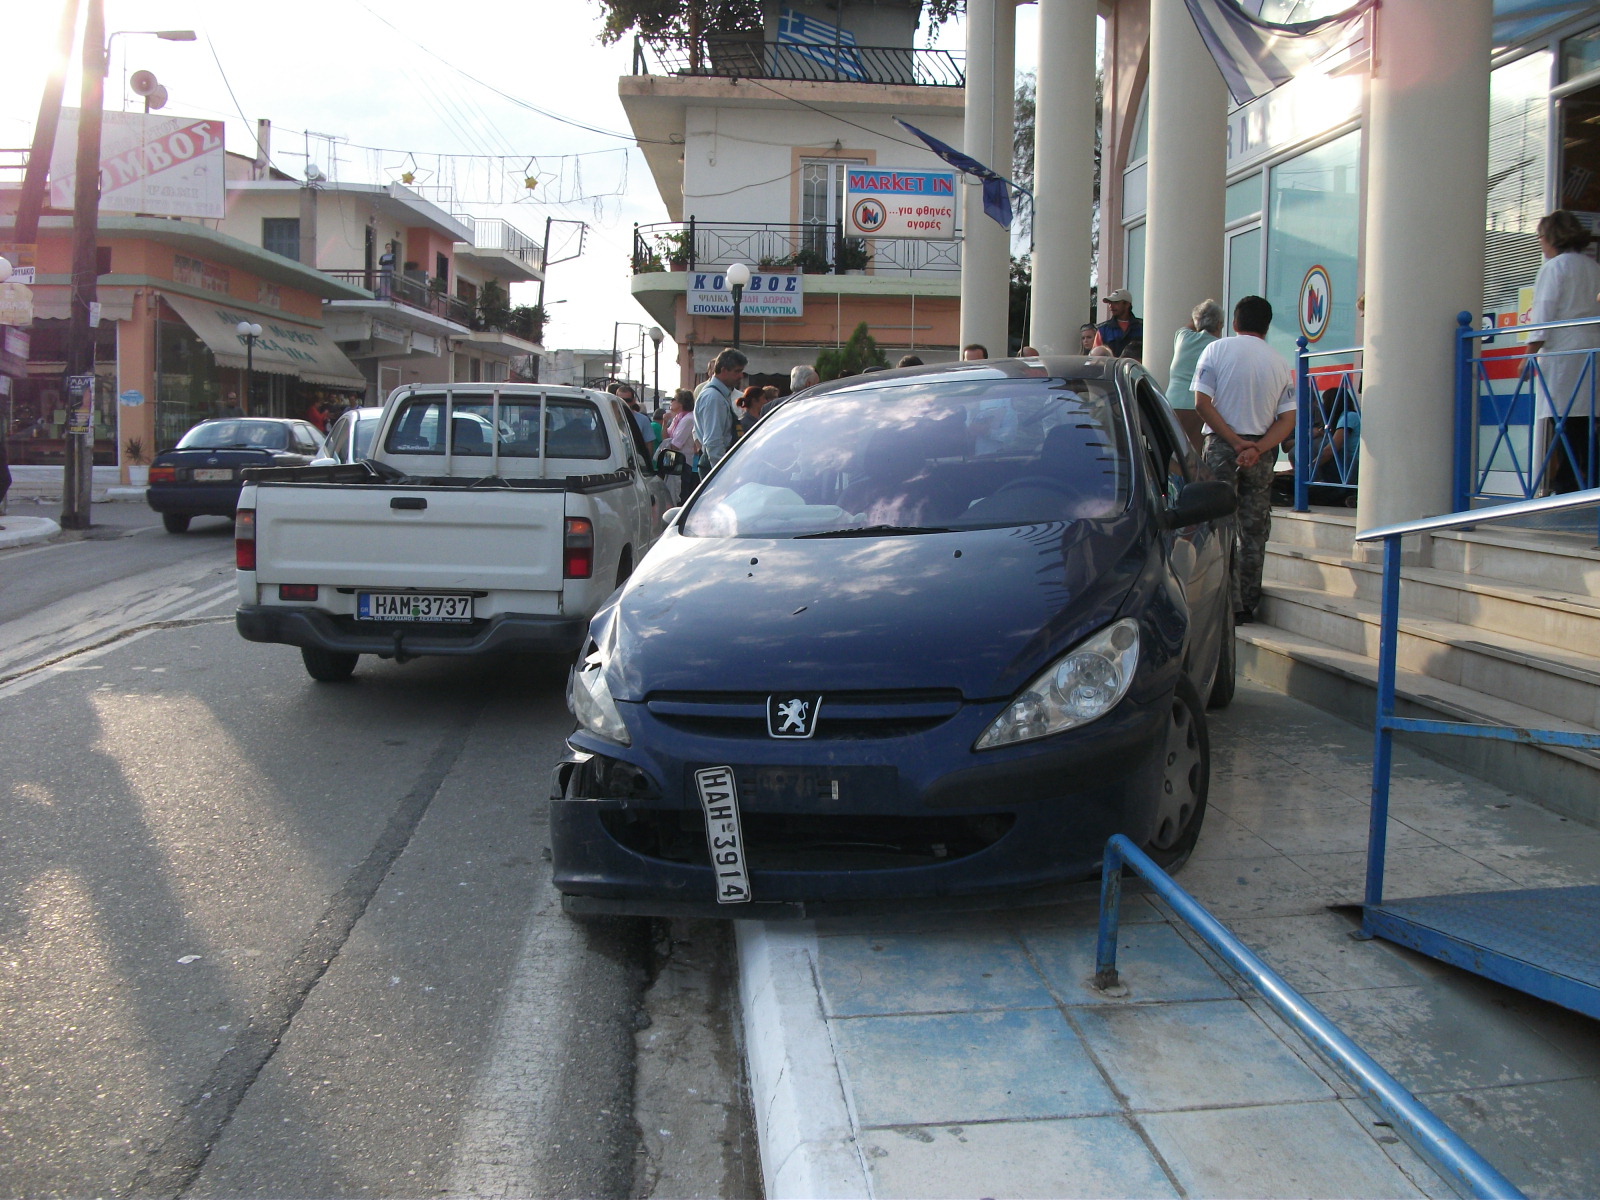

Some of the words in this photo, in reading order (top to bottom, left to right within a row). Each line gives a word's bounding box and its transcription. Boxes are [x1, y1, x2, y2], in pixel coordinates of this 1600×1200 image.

[850, 173, 925, 191] MARKET
[933, 178, 952, 193] IN
[916, 205, 952, 218] φθηνές
[907, 219, 942, 230] αγορές
[694, 274, 797, 292] ΚΟΒΟΣ
[698, 293, 729, 303] ΨΙΛΙΚΑ
[762, 295, 793, 304] ΔΩΡΩΝ
[743, 305, 797, 314] ΑΝΑΨΥΚΤΙΚΑ
[375, 596, 469, 616] HAM-3737
